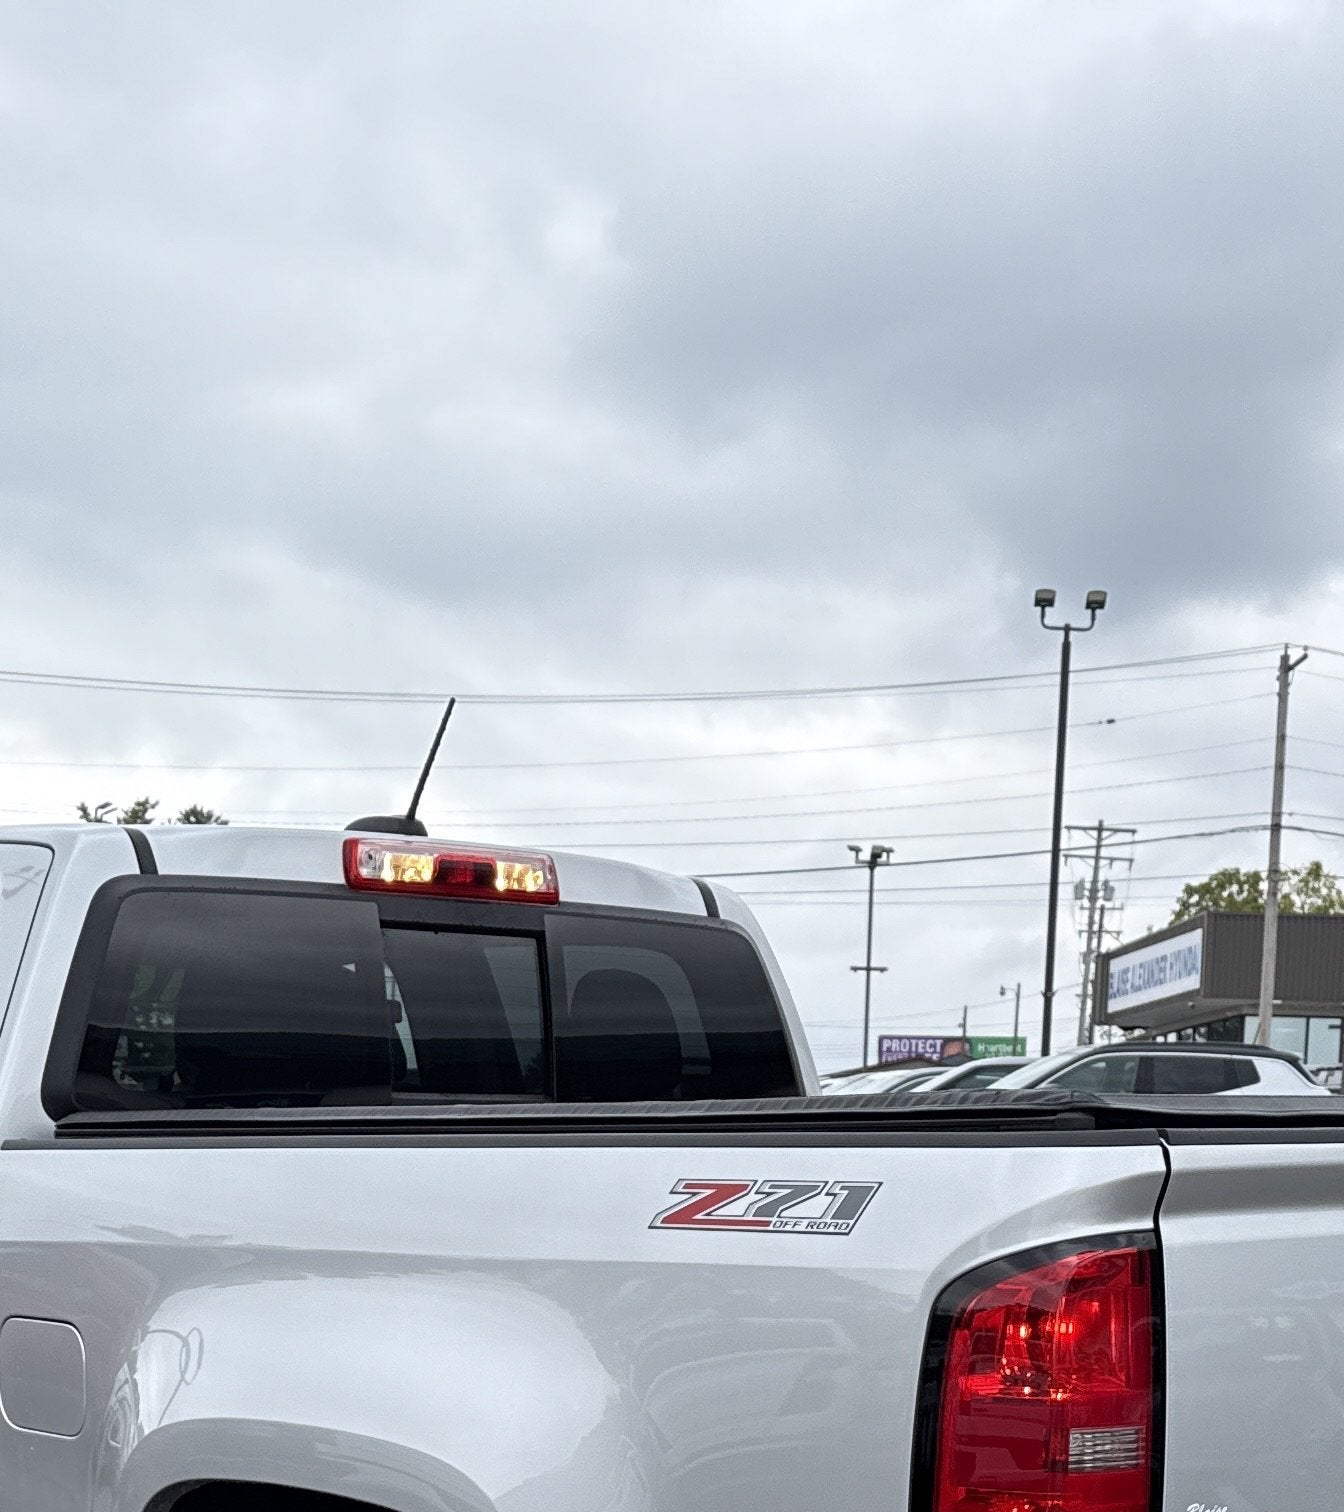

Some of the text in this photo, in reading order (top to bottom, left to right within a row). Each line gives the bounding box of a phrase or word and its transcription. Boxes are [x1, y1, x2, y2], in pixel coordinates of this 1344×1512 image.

[882, 1038, 944, 1052] PROTECT
[648, 1178, 884, 1236] Z71
[772, 1220, 851, 1231] OFF ROAD
